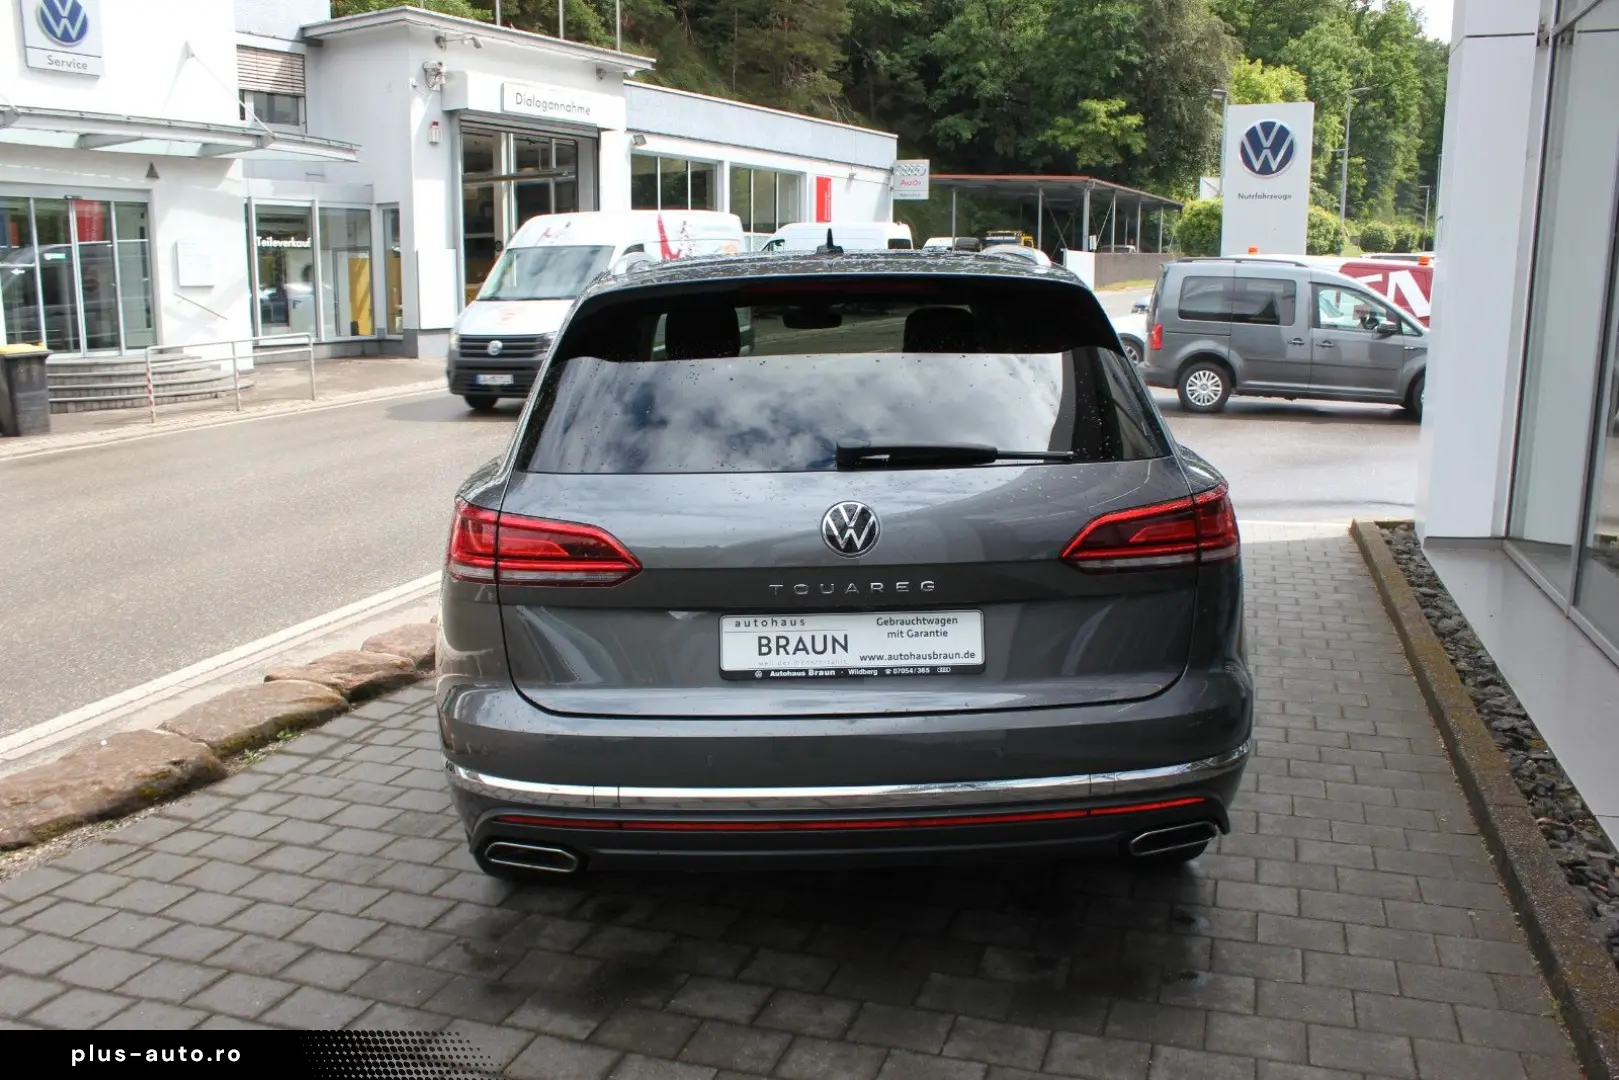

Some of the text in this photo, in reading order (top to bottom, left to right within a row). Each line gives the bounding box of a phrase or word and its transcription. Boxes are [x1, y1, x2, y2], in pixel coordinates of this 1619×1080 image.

[46, 55, 88, 70] Service
[515, 92, 591, 116] Dialogannahme
[899, 178, 922, 186] Audi
[1237, 192, 1292, 201] Nutzfahrzeuge
[256, 236, 312, 248] Teileverkauf
[769, 580, 936, 596] TOUAREG
[734, 617, 806, 628] autohaus
[876, 616, 959, 627] Gebrauchtwagen
[887, 628, 949, 639] mit Garantie
[757, 634, 849, 656] BRAUN
[859, 650, 976, 662] www.autohausbraun.de
[847, 668, 878, 676] Wildberg
